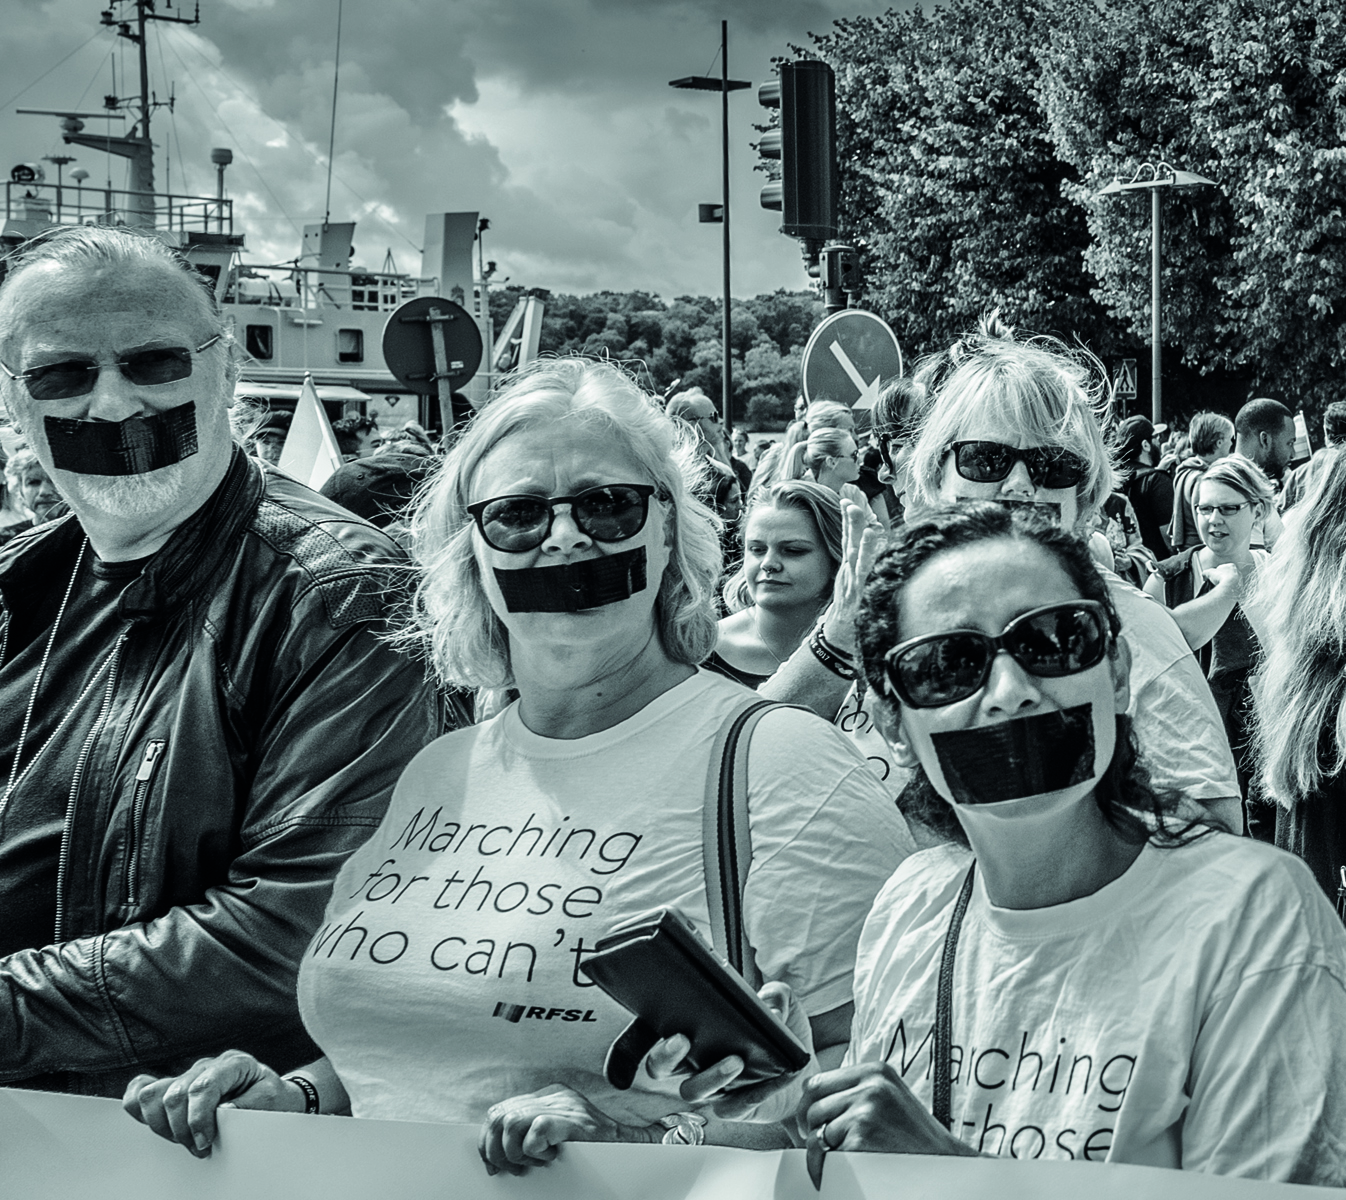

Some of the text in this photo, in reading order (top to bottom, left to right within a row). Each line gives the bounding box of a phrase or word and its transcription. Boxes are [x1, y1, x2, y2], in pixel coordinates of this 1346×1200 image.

[389, 806, 643, 875] Marching
[349, 859, 603, 919] for those
[525, 1006, 598, 1023] RFSL
[884, 1018, 1137, 1112] Marching
[951, 1103, 1113, 1161] hose
